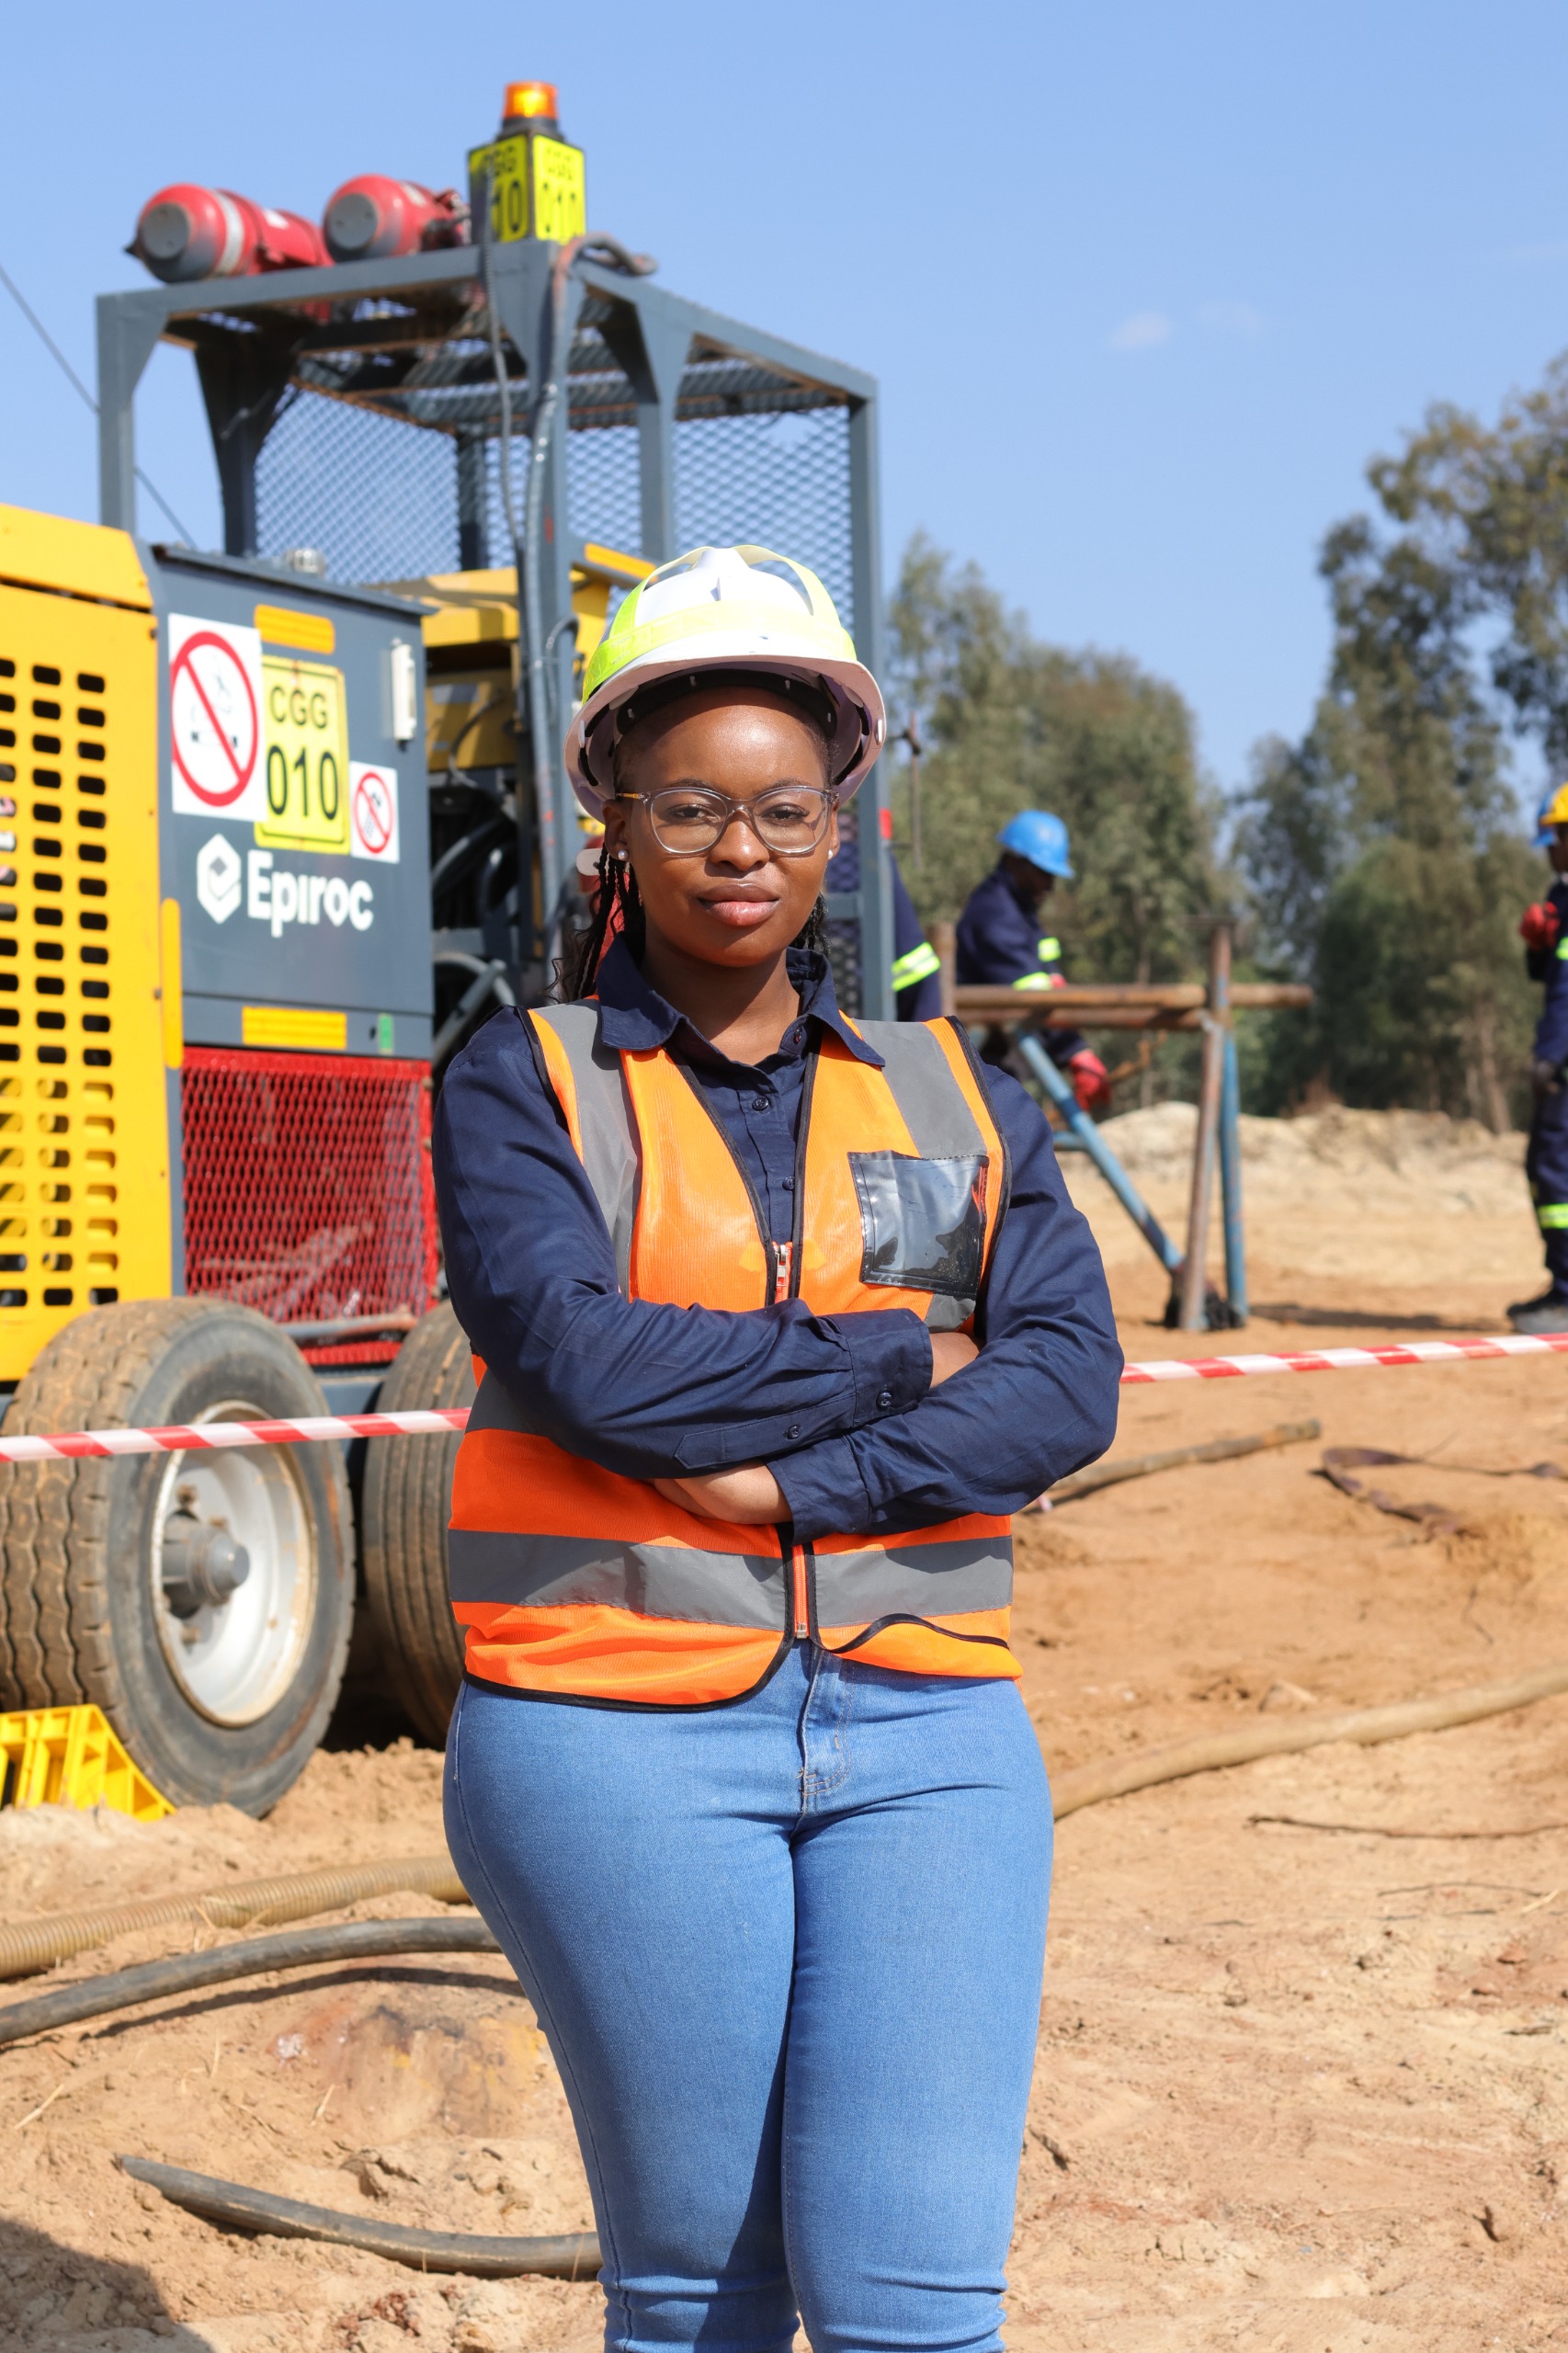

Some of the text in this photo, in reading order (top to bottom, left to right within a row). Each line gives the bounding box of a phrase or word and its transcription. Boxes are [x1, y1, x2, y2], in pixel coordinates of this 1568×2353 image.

[269, 686, 327, 729] CGG
[267, 745, 339, 821] 010
[247, 849, 374, 939] Epiroc
